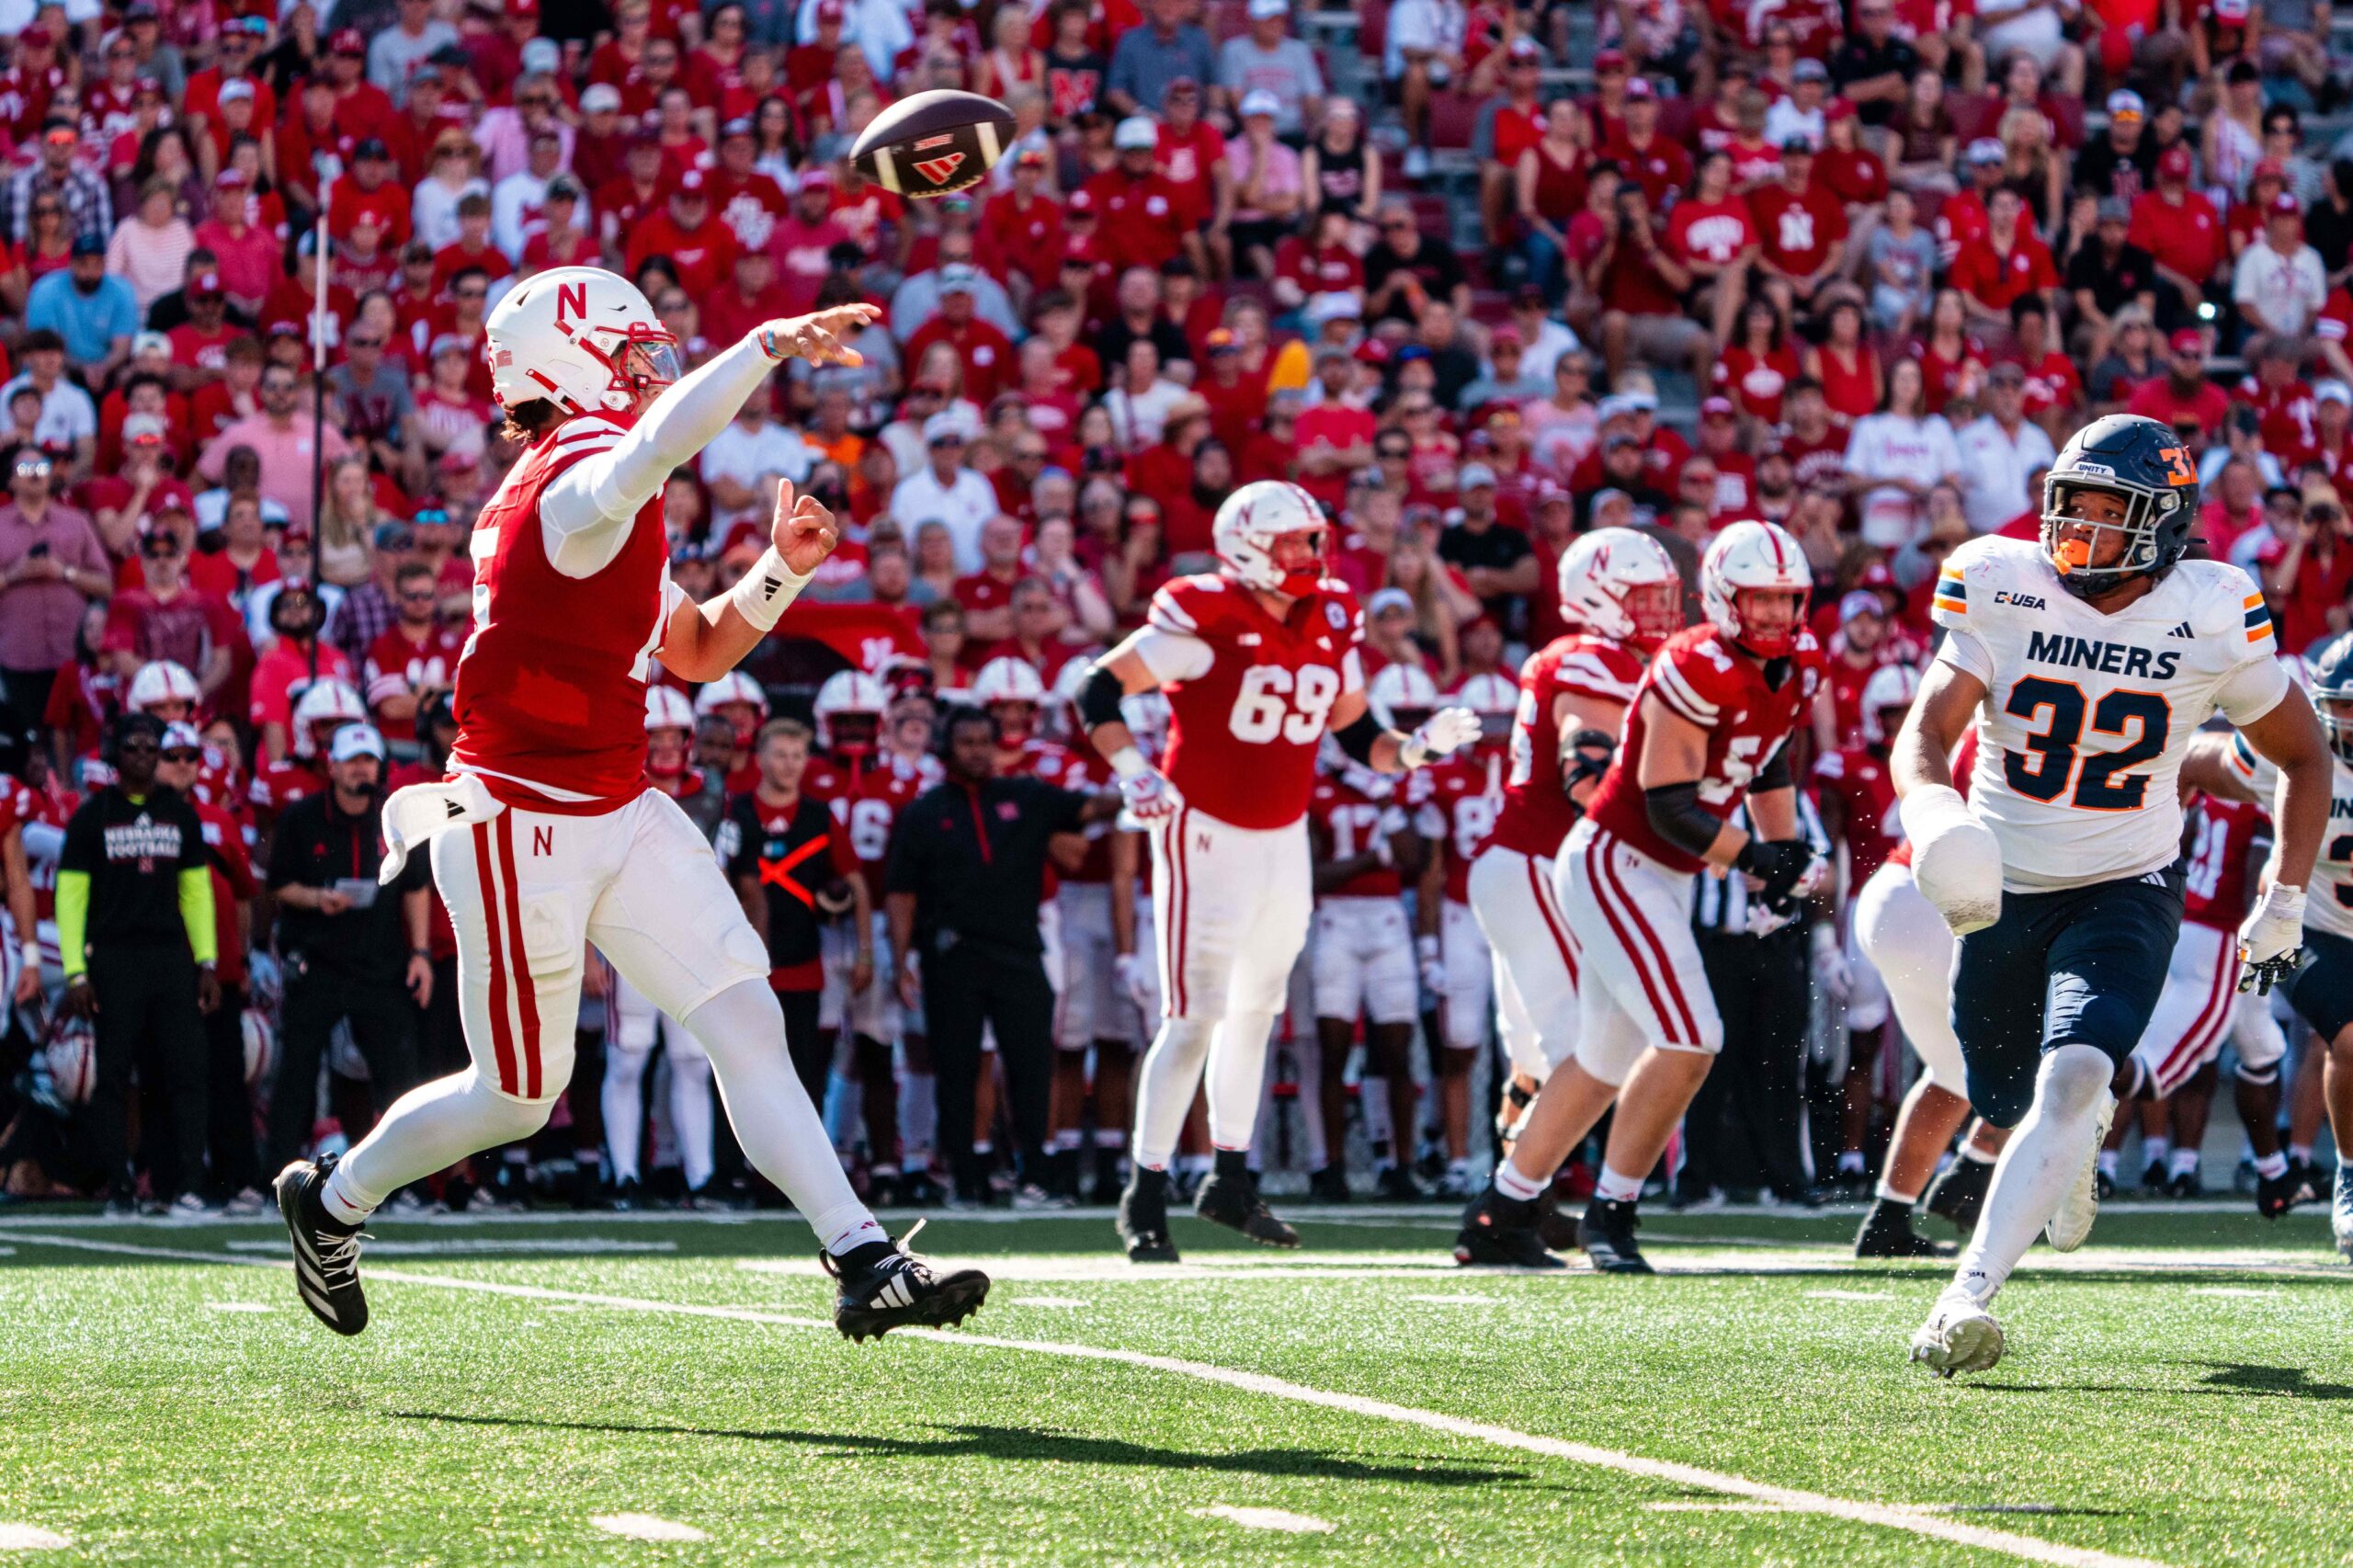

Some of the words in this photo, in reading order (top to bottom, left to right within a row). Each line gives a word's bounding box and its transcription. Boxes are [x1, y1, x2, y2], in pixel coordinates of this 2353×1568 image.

[558, 283, 586, 320] N
[2078, 464, 2108, 474] UNITY
[2027, 631, 2181, 680] MINERS
[1228, 664, 1339, 744] 69
[2003, 674, 2173, 812] 32
[534, 825, 553, 857] N
